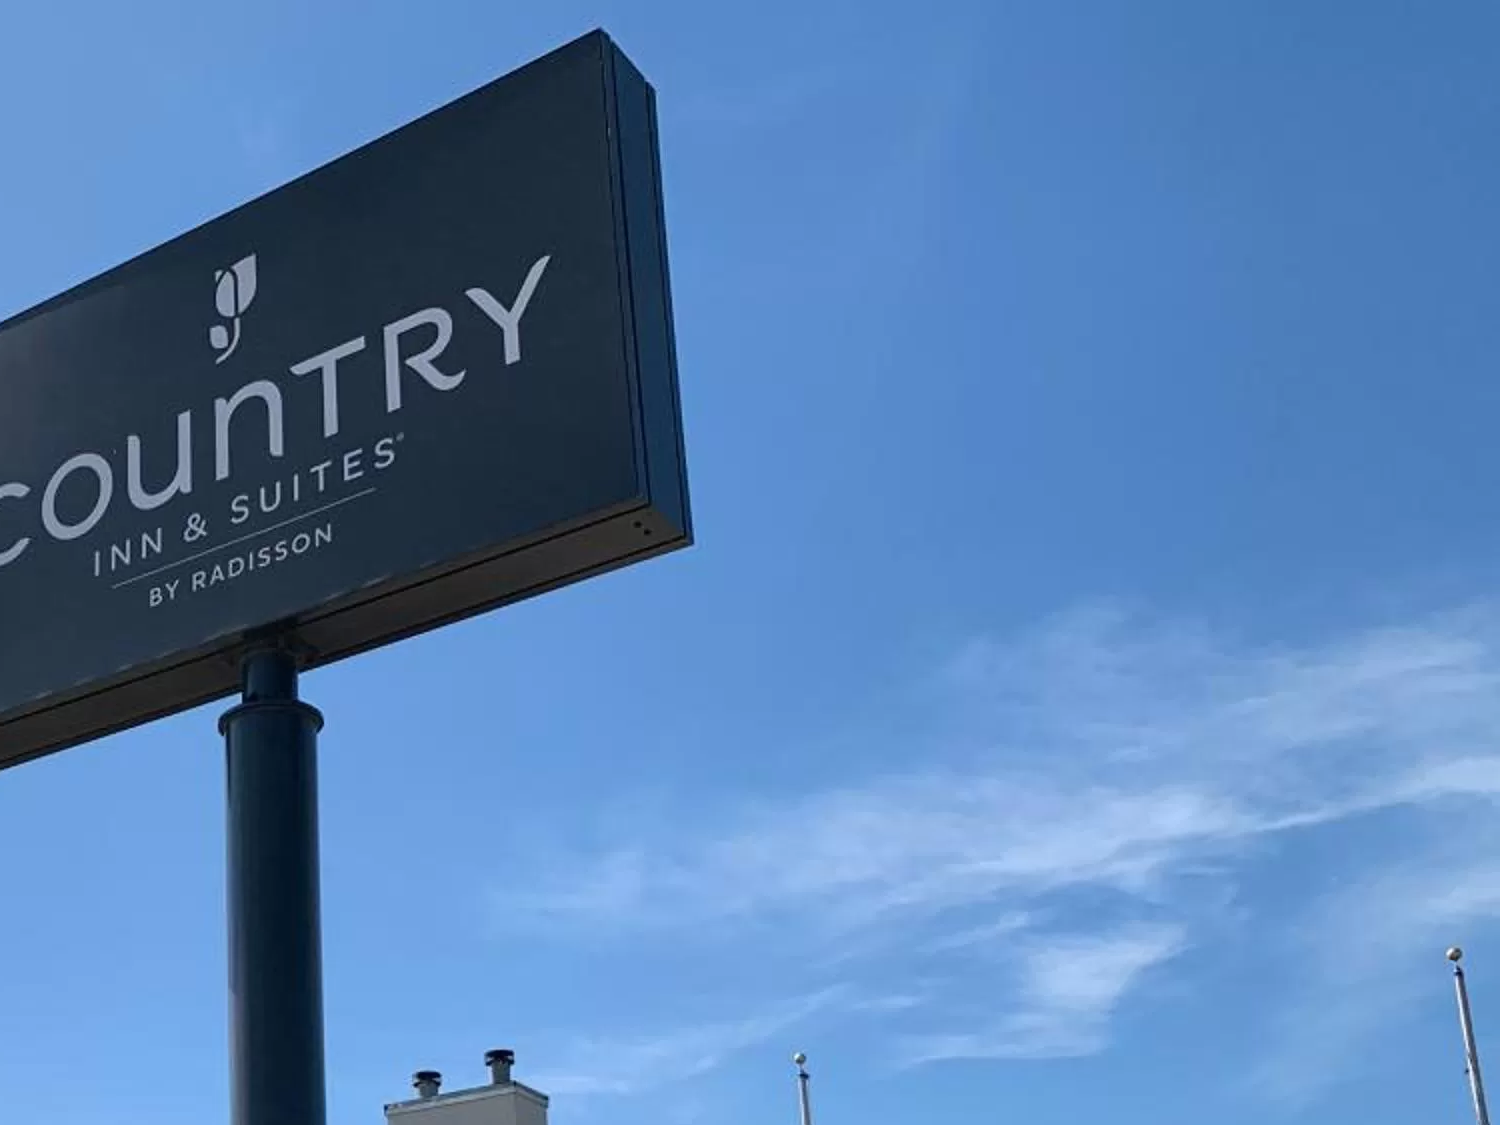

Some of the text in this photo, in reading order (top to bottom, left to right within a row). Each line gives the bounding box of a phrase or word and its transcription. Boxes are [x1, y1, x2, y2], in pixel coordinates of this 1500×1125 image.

[93, 527, 163, 577] INN
[183, 513, 208, 542] &
[149, 523, 333, 607] BY RADISSON
